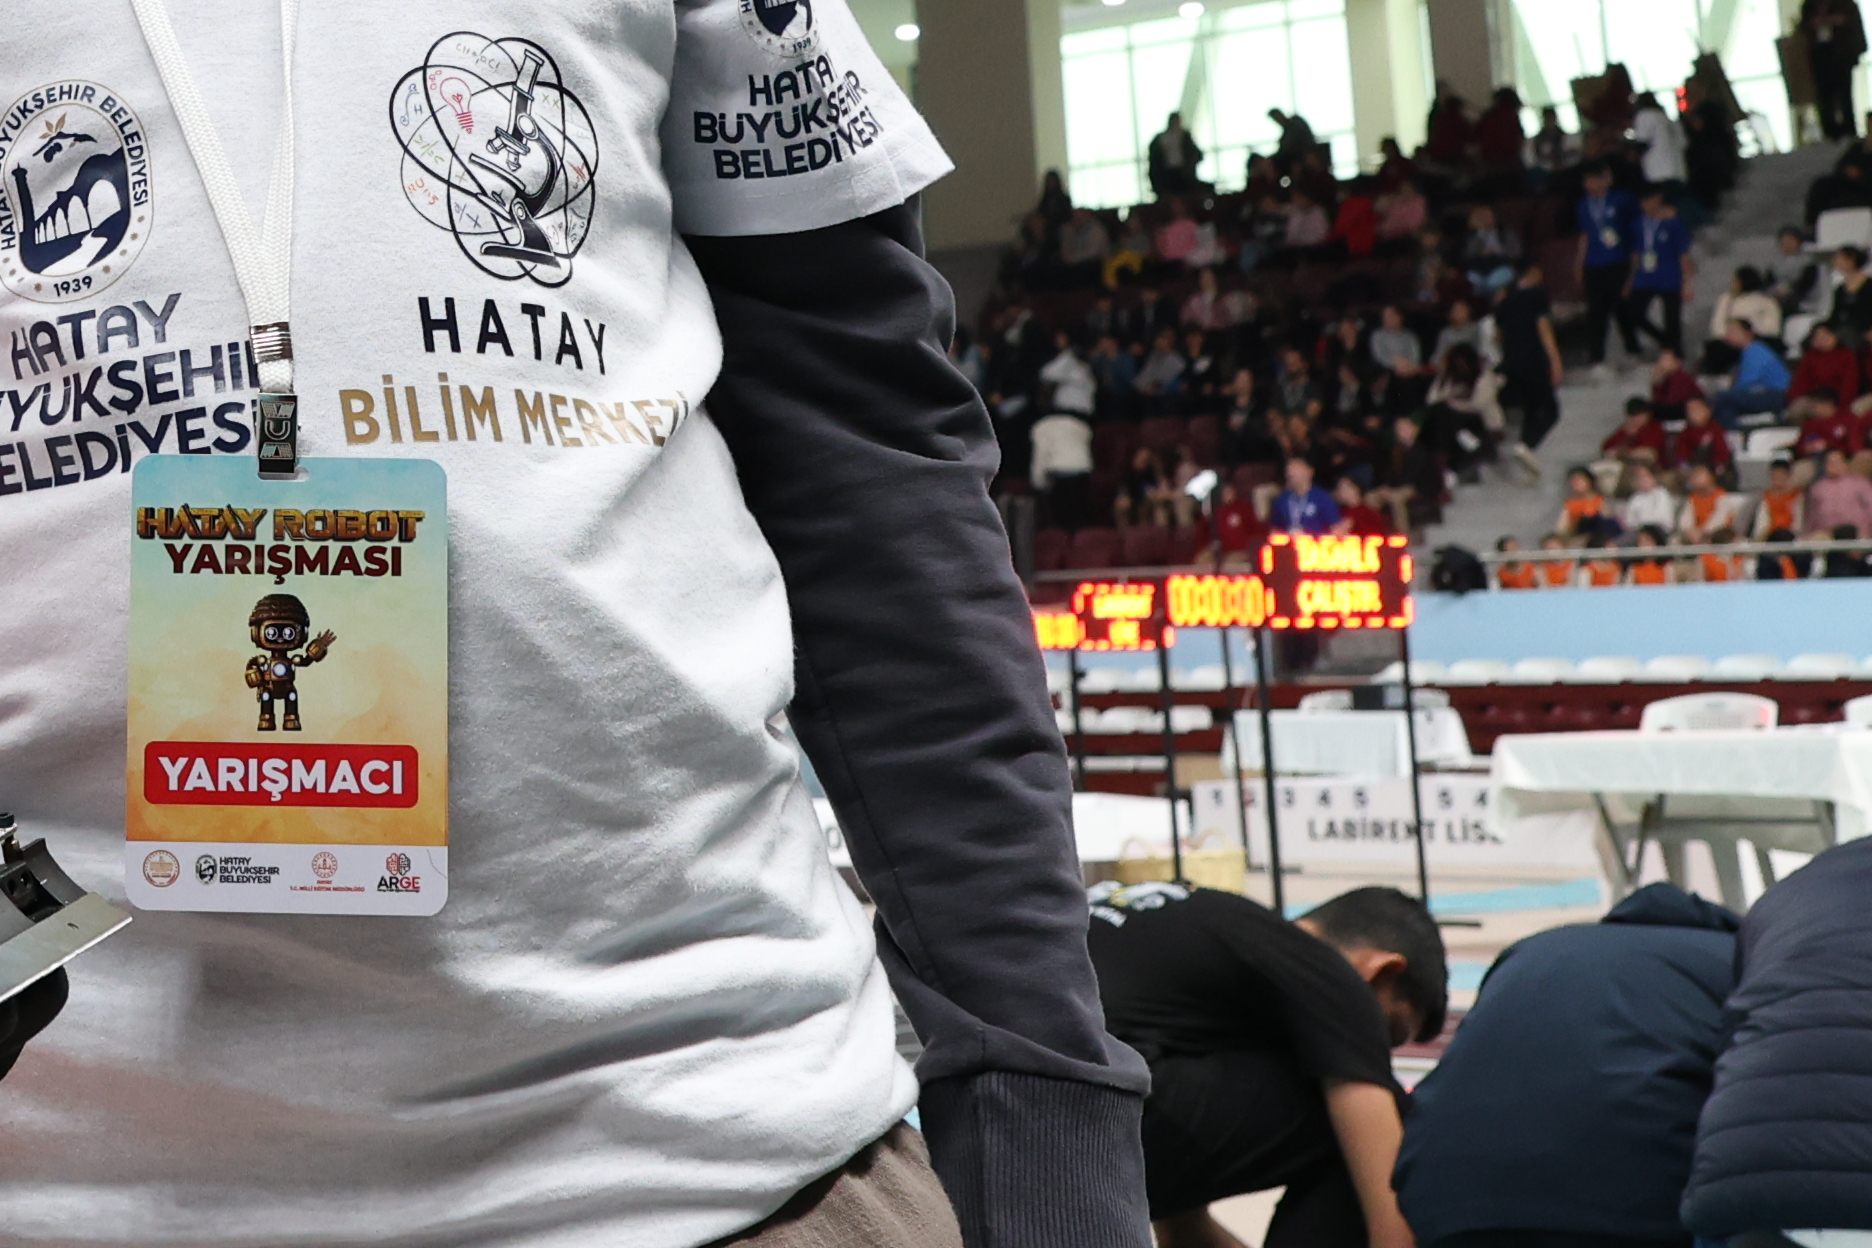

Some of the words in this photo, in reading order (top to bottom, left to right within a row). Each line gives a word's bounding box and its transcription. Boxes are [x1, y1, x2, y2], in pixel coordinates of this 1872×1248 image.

[748, 52, 838, 107] HATA
[54, 275, 93, 297] 1939
[11, 293, 181, 380] HATAY
[418, 296, 606, 376] HATAY
[339, 372, 503, 446] BİLİM
[136, 503, 268, 541] HATAY
[272, 508, 427, 543] ROBOT
[164, 543, 402, 586] YARIŞMASI
[158, 756, 403, 802] YARIŞMACI
[1444, 814, 1504, 845] LİS
[378, 875, 421, 890] ARGE
